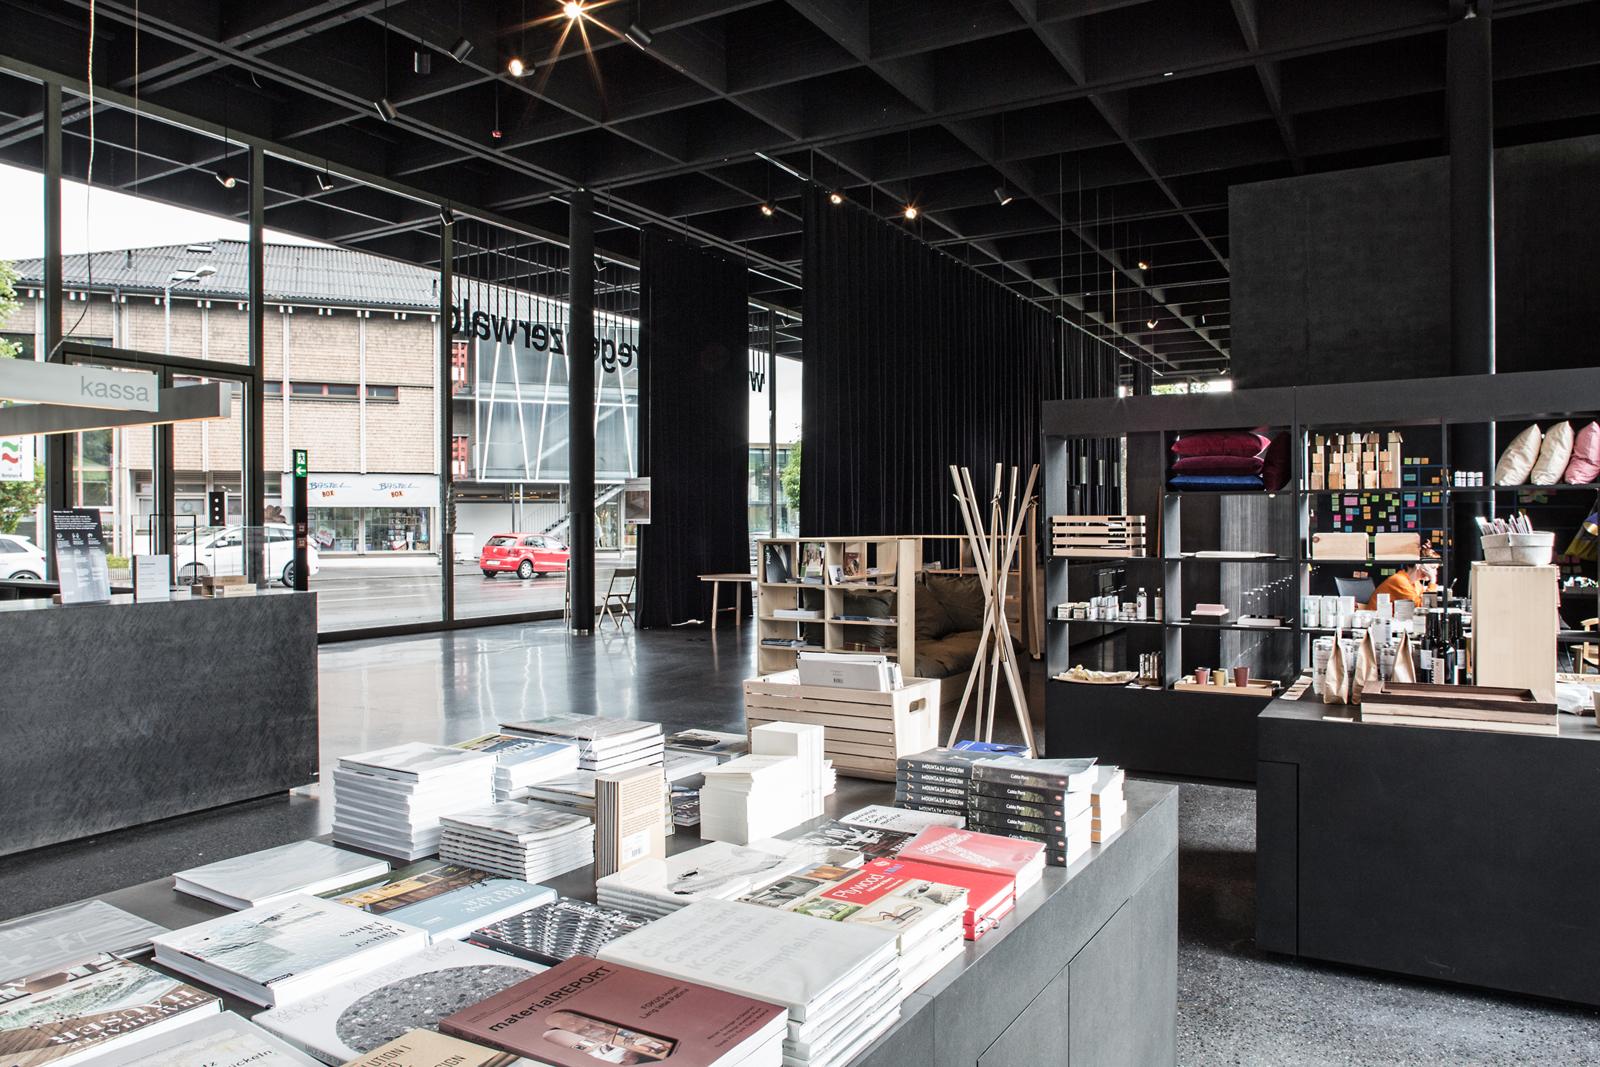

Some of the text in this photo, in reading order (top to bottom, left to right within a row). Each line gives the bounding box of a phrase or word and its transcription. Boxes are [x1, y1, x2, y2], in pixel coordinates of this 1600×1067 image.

[81, 375, 149, 402] kassa
[921, 795, 944, 803] MOUNTAIN
[946, 787, 964, 795] MODERN
[832, 873, 885, 898] Plywood
[488, 966, 612, 1032] materialREPORT
